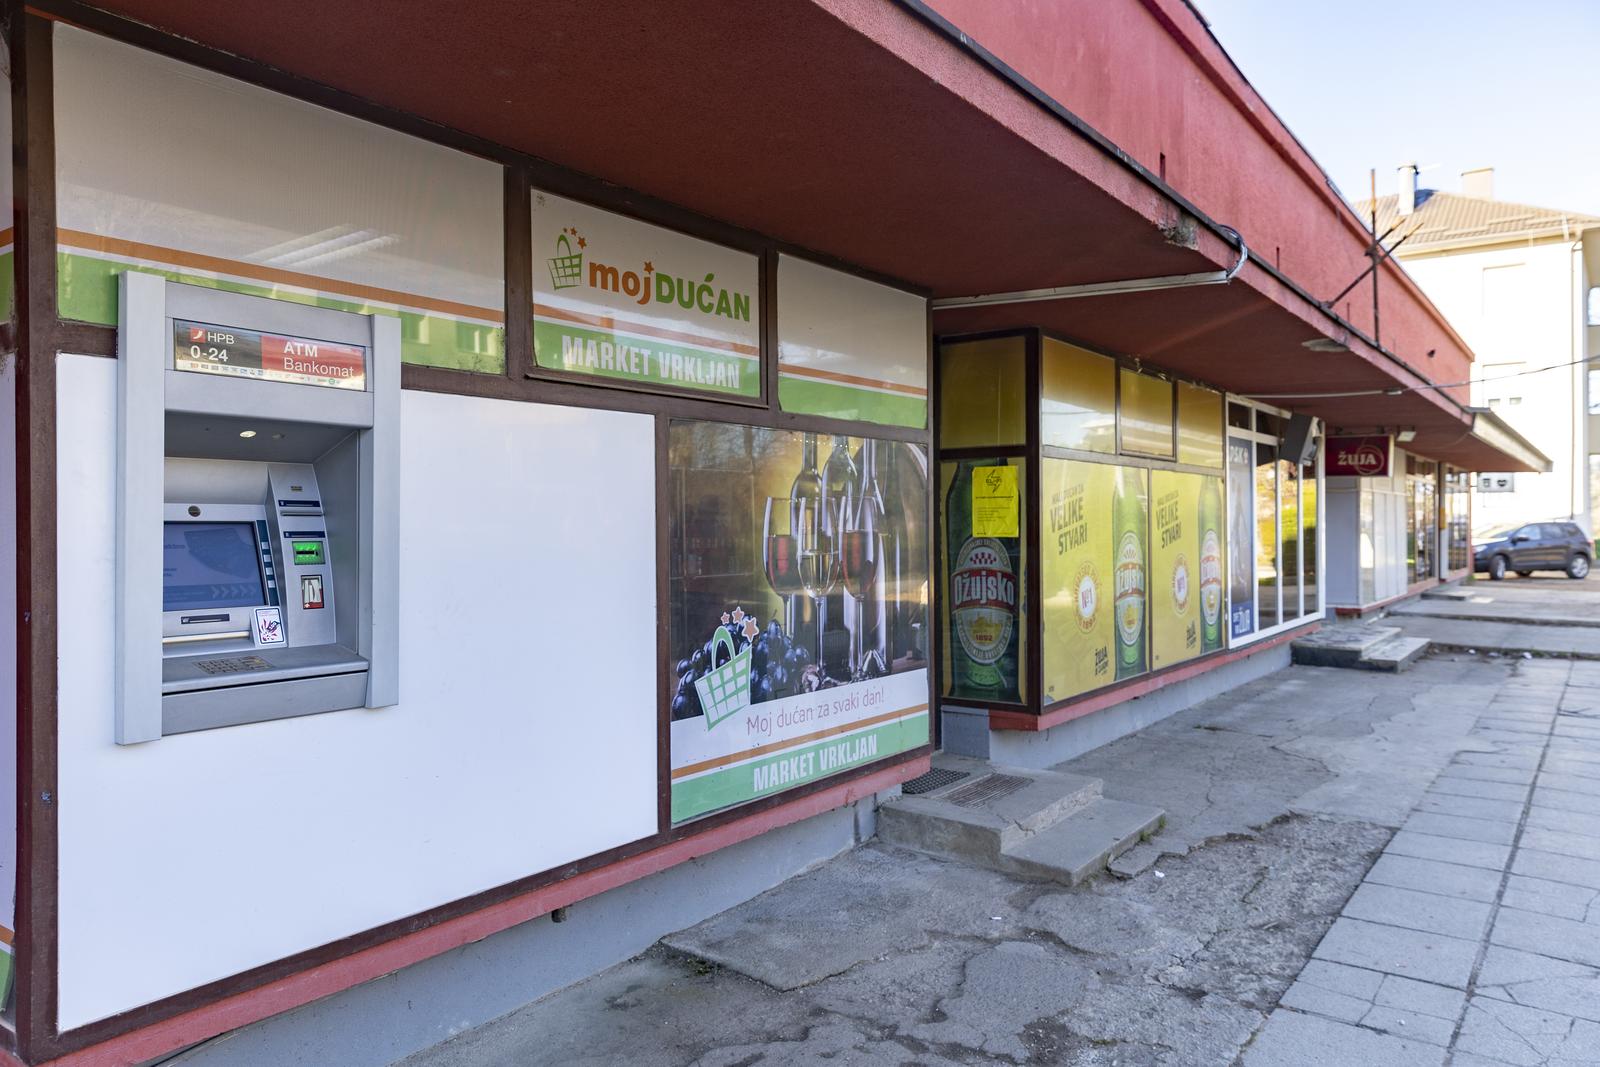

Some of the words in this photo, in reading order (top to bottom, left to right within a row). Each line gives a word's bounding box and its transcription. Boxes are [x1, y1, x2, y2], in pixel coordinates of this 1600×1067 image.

[190, 345, 229, 362] 0-24
[207, 331, 235, 345] HPB
[283, 341, 318, 358] ATM
[283, 357, 354, 377] Bankomat
[562, 335, 651, 377] MARKET
[658, 351, 740, 389] VRKLJAN
[1337, 450, 1377, 466] ŽUJA
[1050, 496, 1084, 534] VELIKE
[1155, 500, 1179, 531] VELIKE
[1058, 522, 1088, 556] STVARI
[1161, 520, 1182, 549] STVARI
[954, 570, 1015, 606] Ožujsko
[746, 716, 773, 738] Moj
[776, 705, 814, 726] dućan
[817, 703, 830, 719] za
[833, 692, 860, 715] svaki
[862, 687, 885, 708] dan!
[753, 752, 816, 793] MARKET
[819, 734, 878, 772] VRKLJAN
